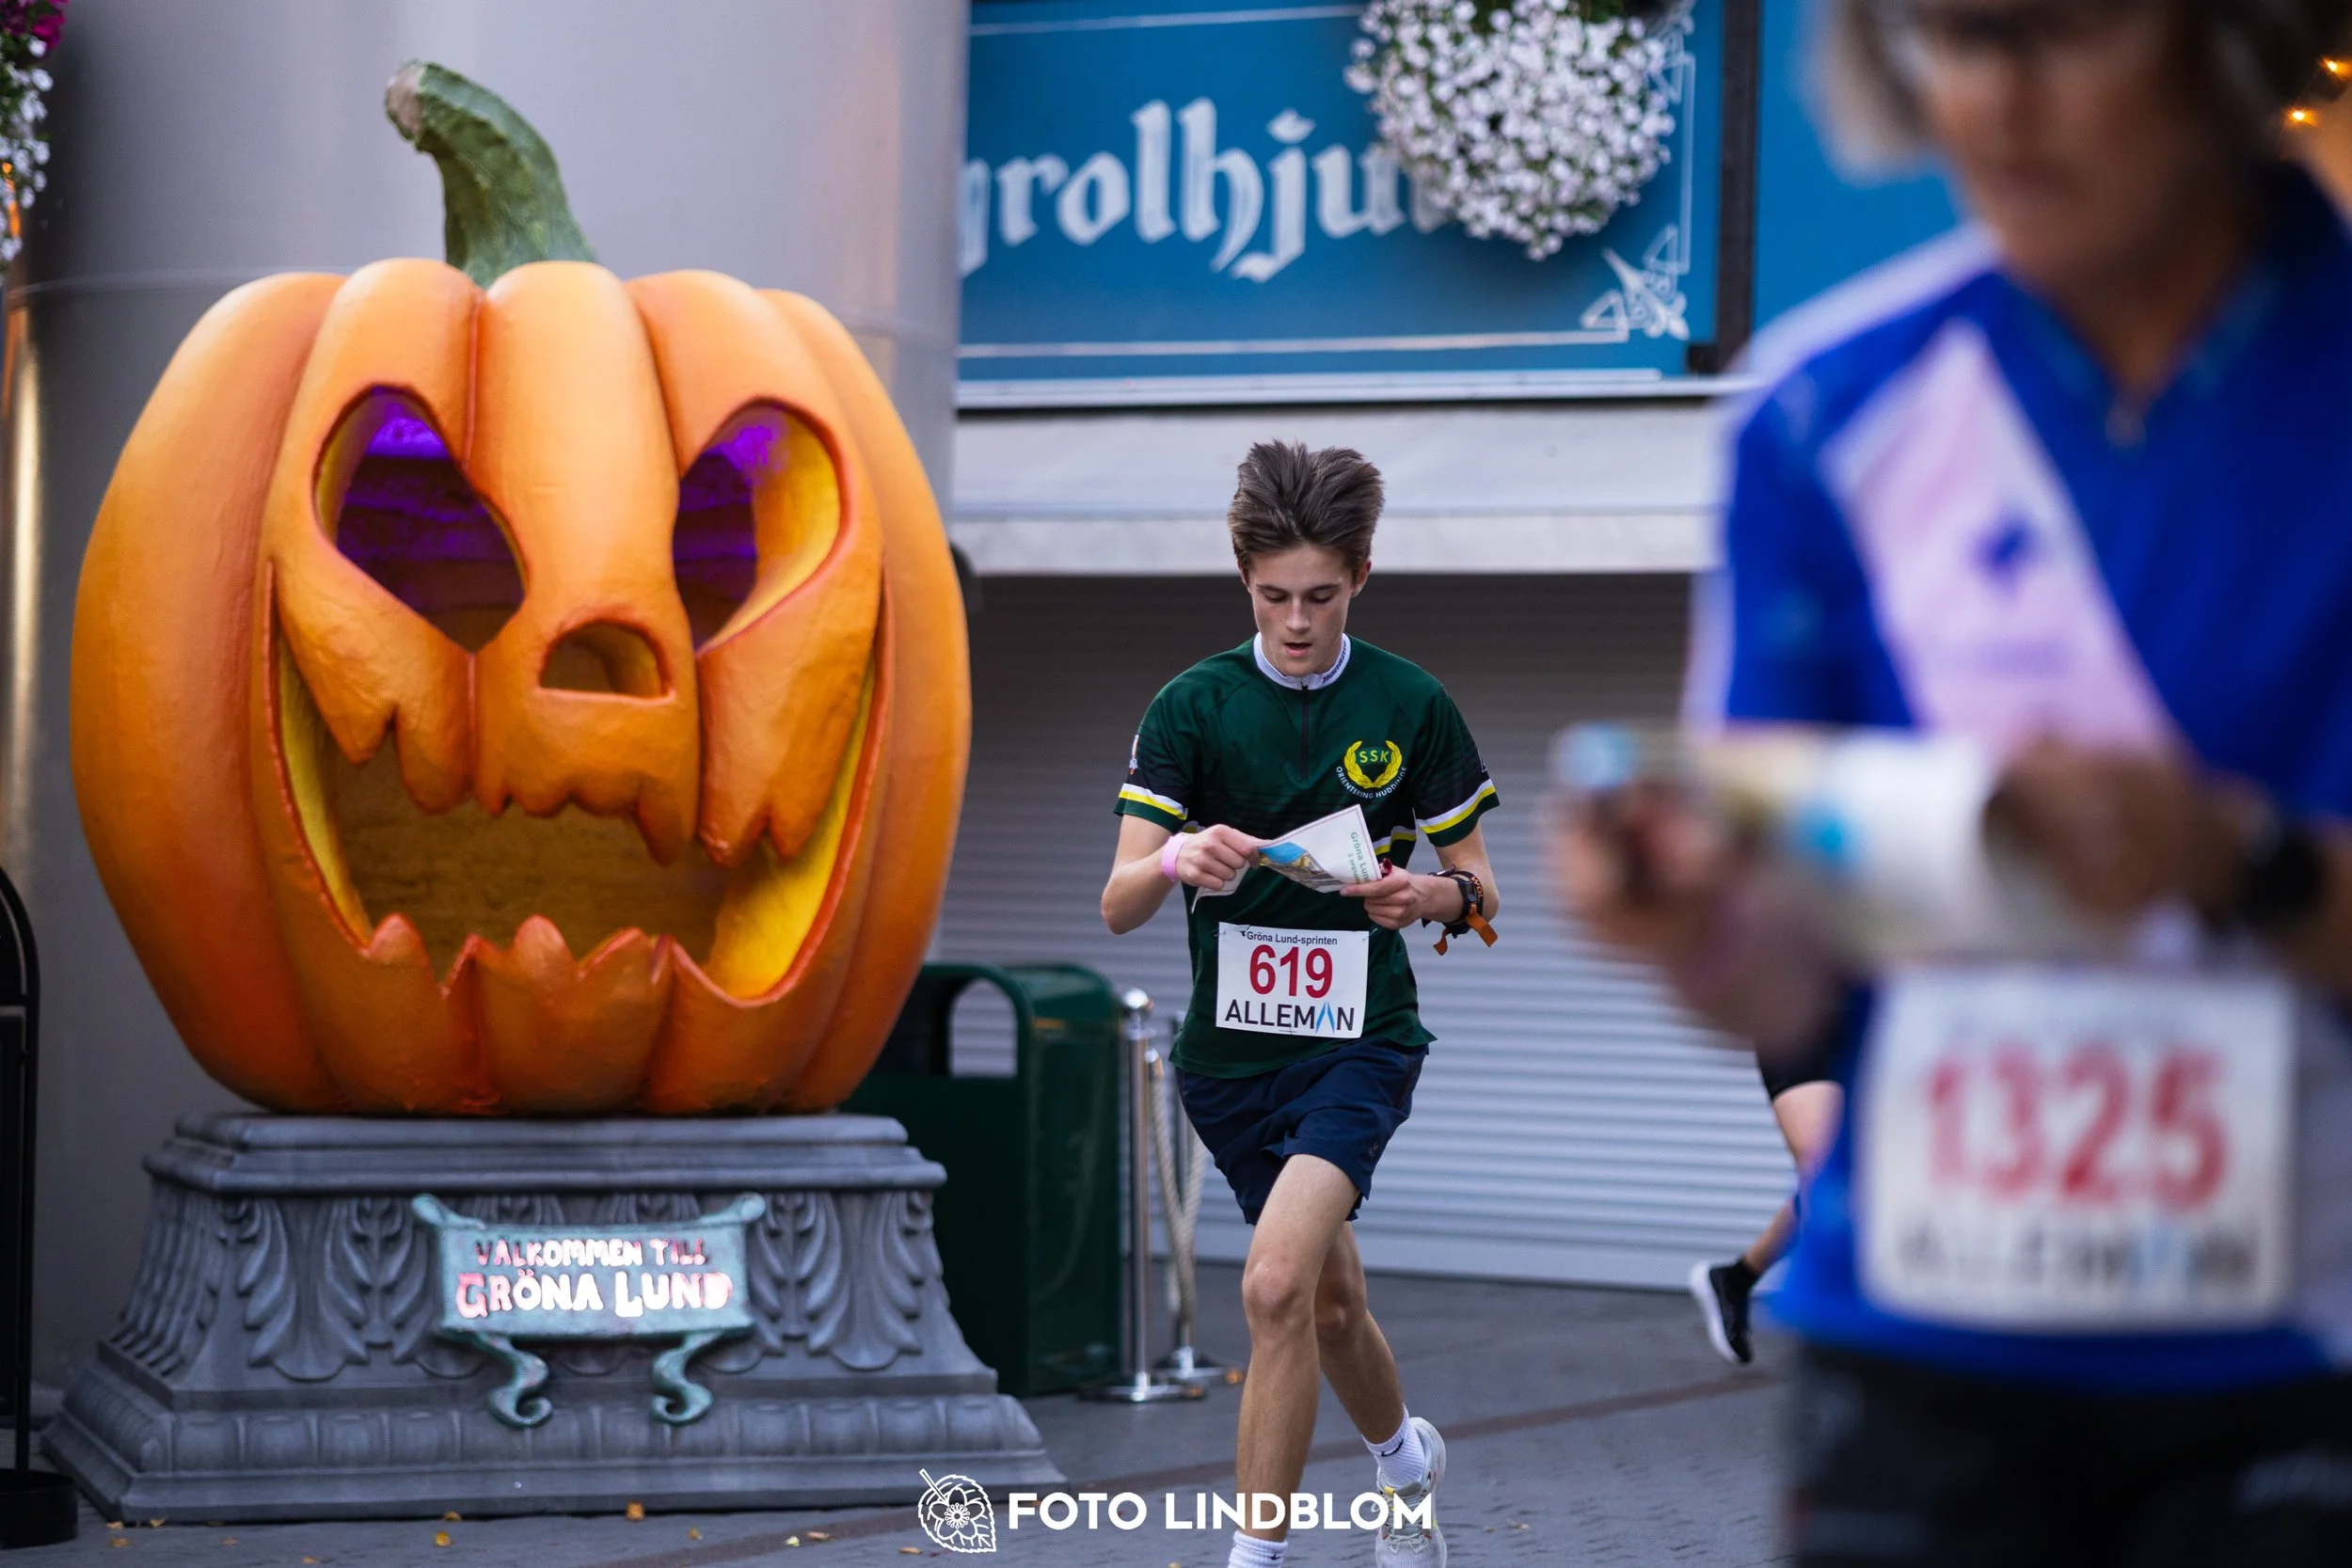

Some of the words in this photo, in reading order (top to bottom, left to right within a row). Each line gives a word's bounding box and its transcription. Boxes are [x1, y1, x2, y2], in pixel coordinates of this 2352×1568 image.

[1359, 750, 1390, 764] SSK
[1336, 766, 1374, 799] ORIENTERING
[1375, 767, 1407, 798] HUDDINGE
[1350, 832, 1364, 861] Gröna
[1247, 930, 1273, 942] Gröna
[1275, 934, 1338, 946] Lund-sprinten
[1249, 943, 1333, 999] 619
[1225, 999, 1355, 1034] ALLEMAN
[1922, 1040, 2230, 1213] 1325
[475, 1235, 643, 1267] VÄLKOMMEN
[650, 1238, 708, 1266] TILL
[455, 1269, 604, 1319] GRÖNA
[614, 1271, 734, 1318] LUND
